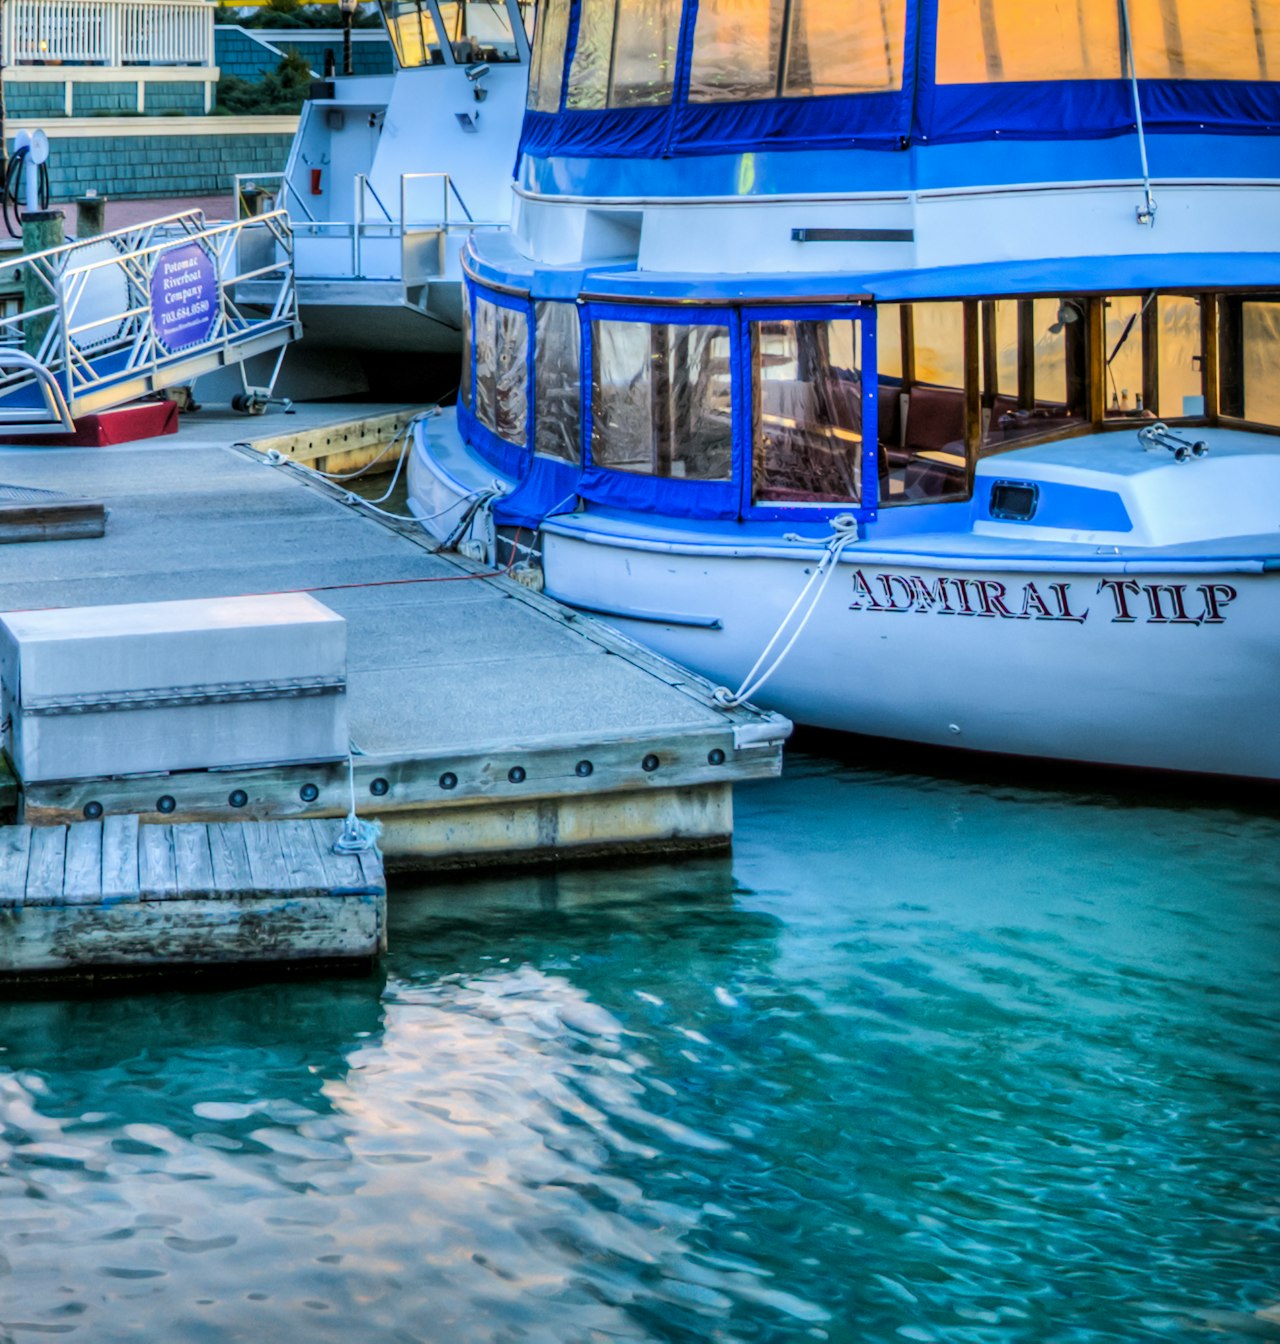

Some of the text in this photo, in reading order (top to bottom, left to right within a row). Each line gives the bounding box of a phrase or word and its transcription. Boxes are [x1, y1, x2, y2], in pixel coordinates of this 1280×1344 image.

[164, 257, 198, 275] Potomac
[163, 270, 202, 290] Riverboat
[164, 285, 202, 304] Company
[848, 569, 1238, 627] ADMIRAL TILP
